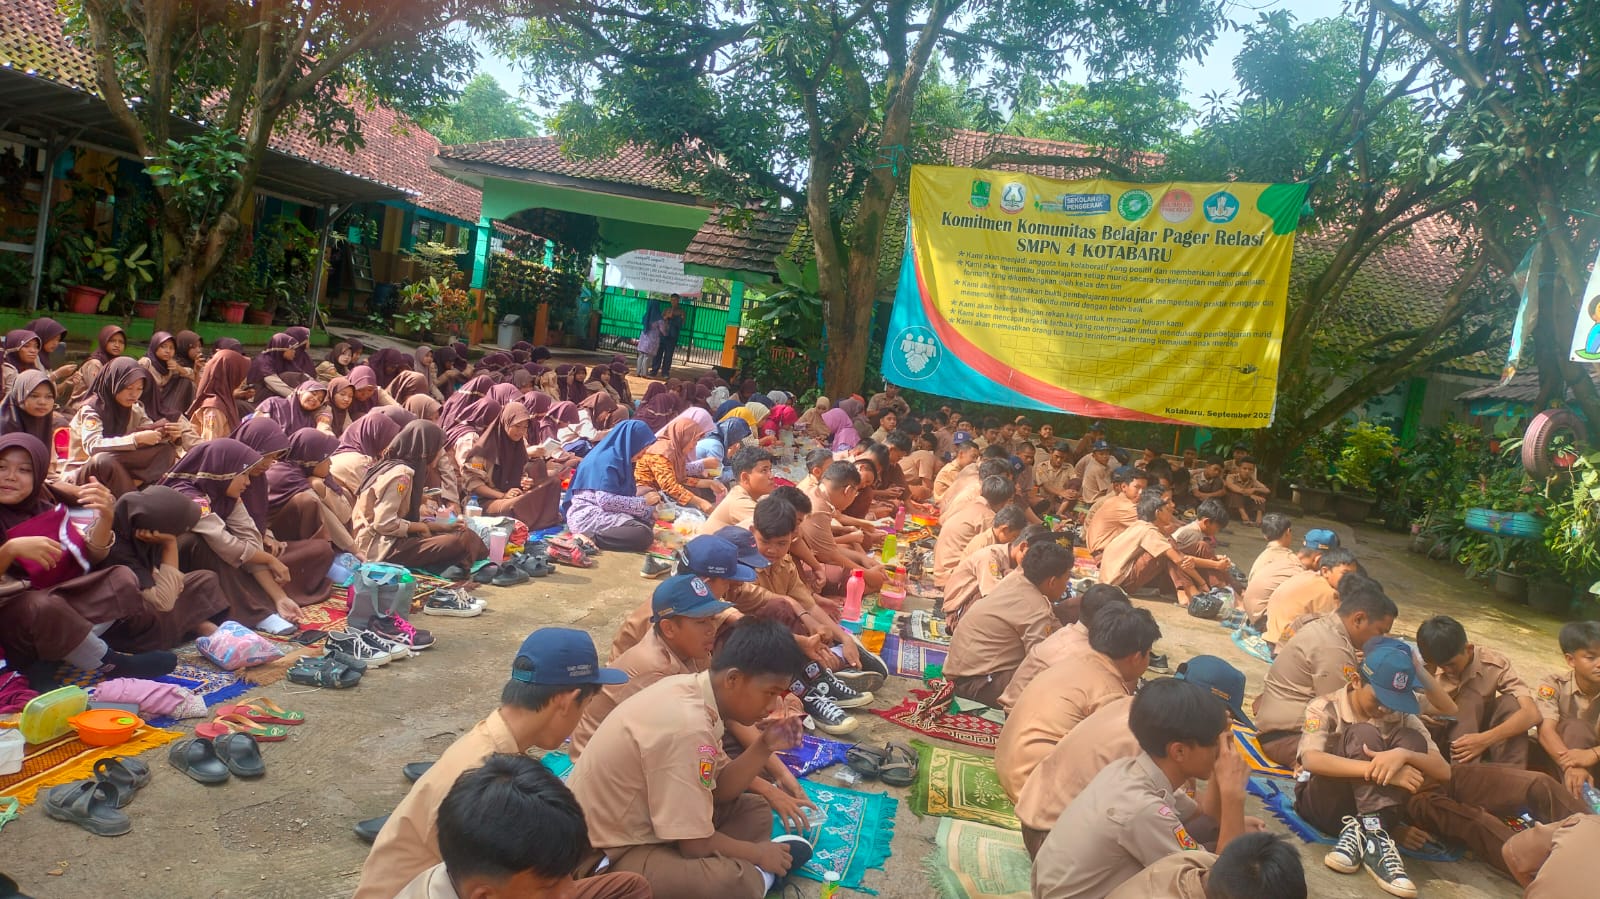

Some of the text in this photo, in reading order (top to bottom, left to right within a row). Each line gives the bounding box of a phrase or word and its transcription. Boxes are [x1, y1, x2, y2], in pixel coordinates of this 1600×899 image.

[942, 212, 1264, 248] Komitmen Komunitas Belajar Pager Relasi
[1016, 238, 1172, 262] SMPN 4 KOTABARU
[1036, 268, 1082, 278] pembelajaran
[1084, 272, 1105, 280] setiap
[1156, 277, 1205, 286] berkelanjutan
[1170, 268, 1214, 276] memberikan
[1008, 274, 1056, 285] dikembangkan
[1063, 291, 1110, 301] pembelajaran
[956, 317, 973, 326] Kami
[974, 320, 990, 328] akan
[1129, 335, 1155, 344] tentang
[1165, 408, 1204, 416] Kotabaru,
[1207, 410, 1251, 418] September
